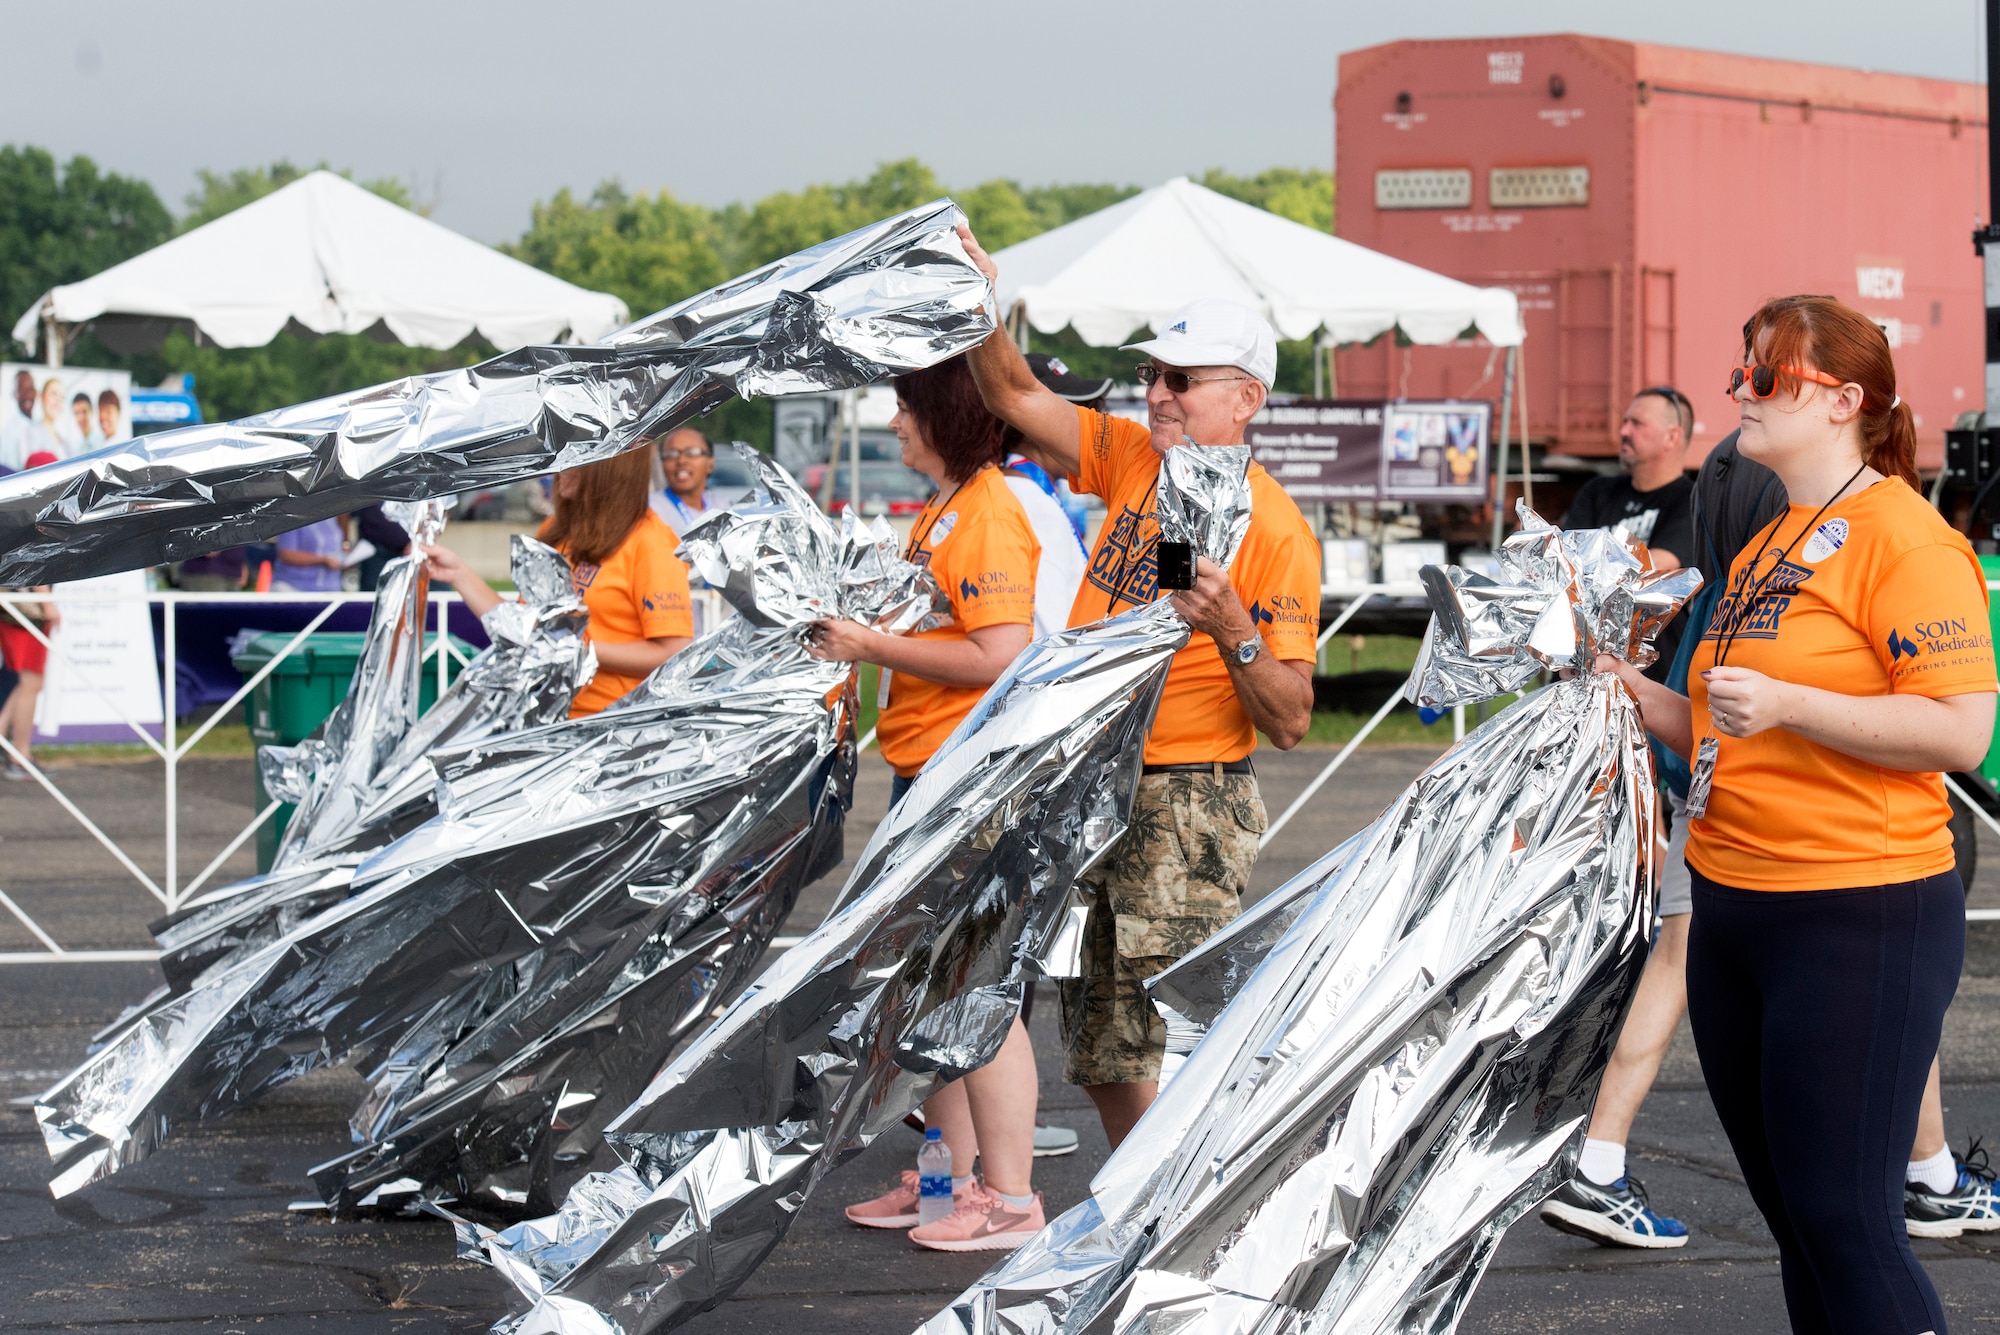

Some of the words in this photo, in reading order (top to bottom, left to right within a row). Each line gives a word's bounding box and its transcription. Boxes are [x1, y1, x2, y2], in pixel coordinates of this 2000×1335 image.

[1856, 266, 1904, 299] WECX
[978, 571, 1009, 586] SOIN
[981, 584, 1017, 596] Medical
[1271, 595, 1303, 612] SOIN
[1276, 611, 1307, 624] Medical
[1915, 618, 1967, 642] SOIN
[1926, 635, 1978, 655] Medical
[1951, 656, 1984, 666] HEALTH
